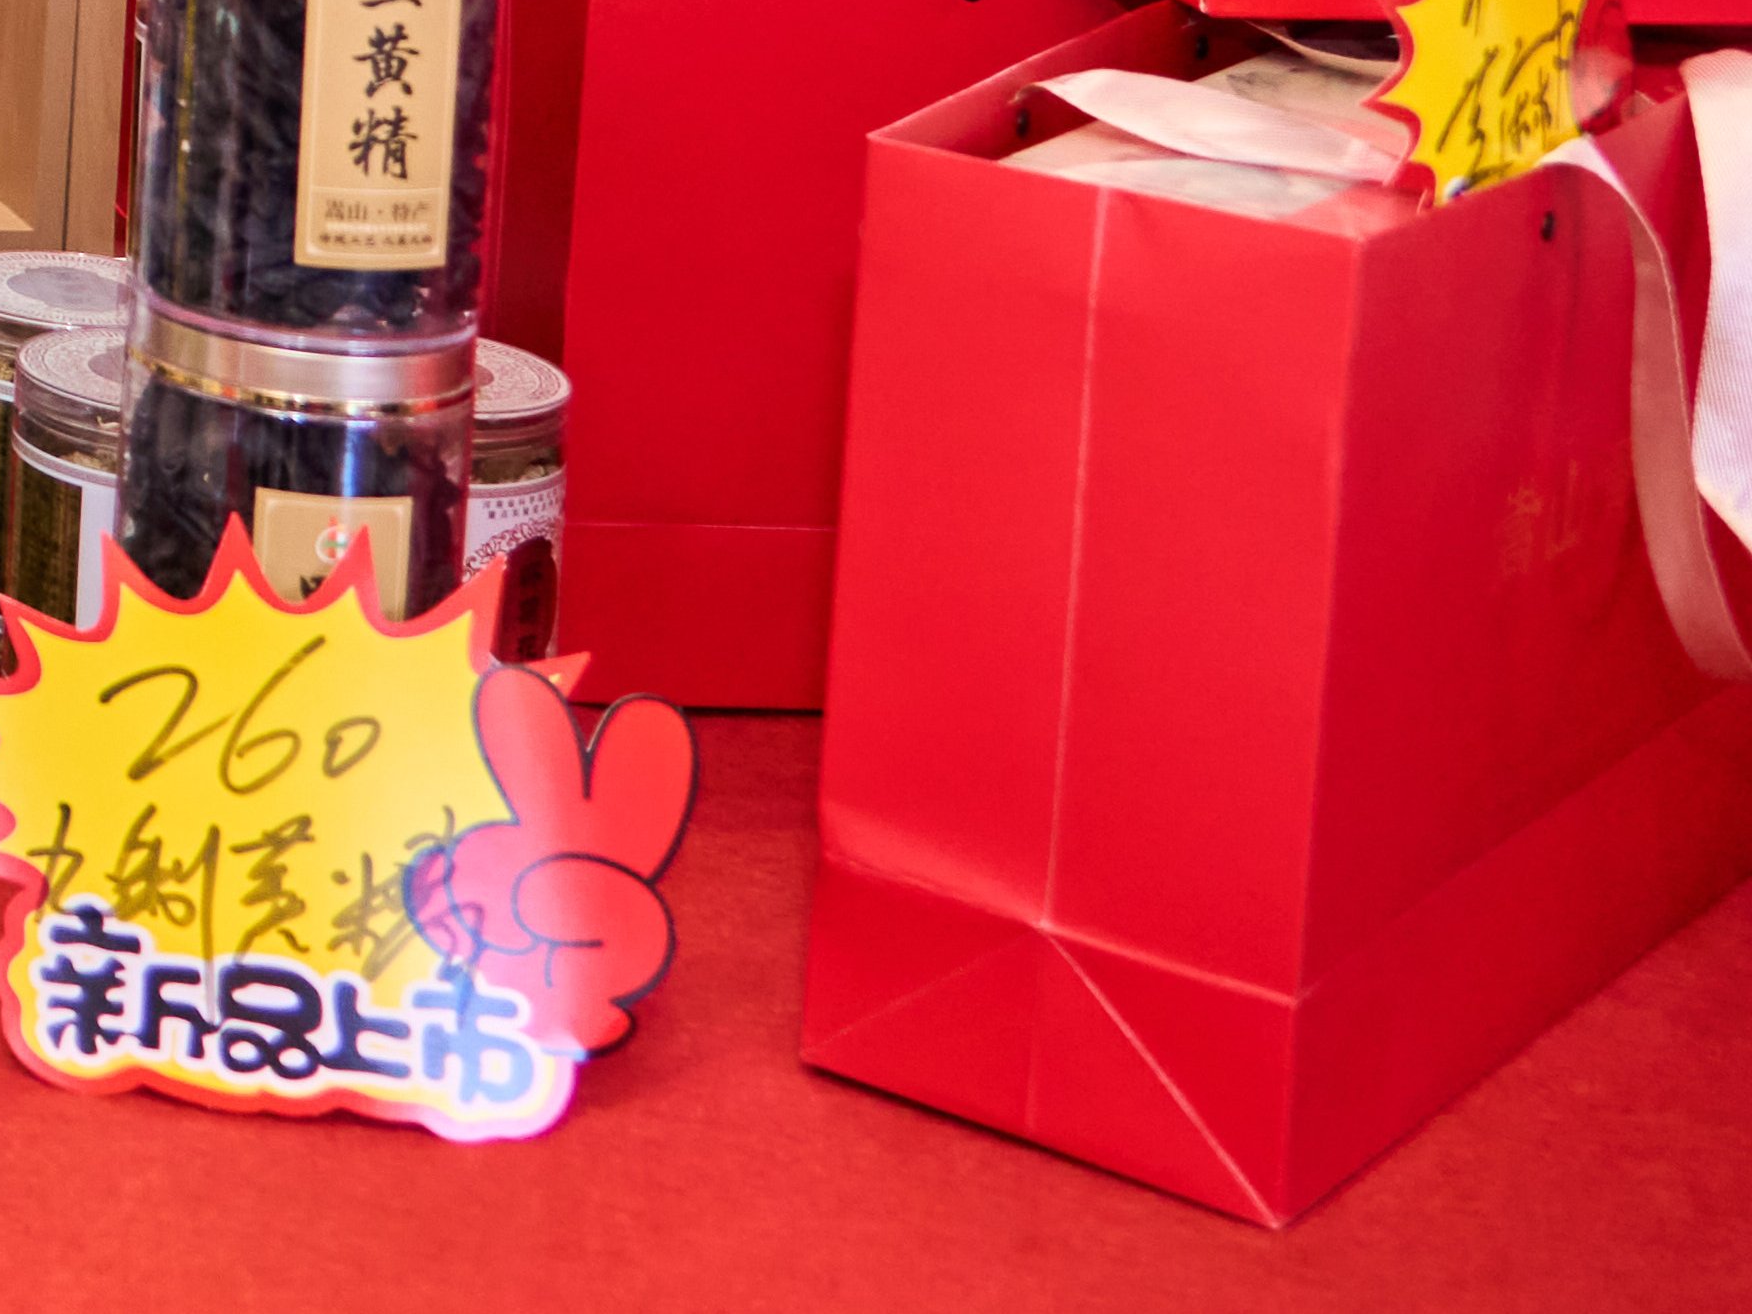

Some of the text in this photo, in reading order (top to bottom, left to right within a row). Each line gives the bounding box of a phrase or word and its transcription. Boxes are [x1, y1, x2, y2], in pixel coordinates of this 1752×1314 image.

[99, 634, 382, 796] 260
[39, 904, 537, 1105] 新品上市
